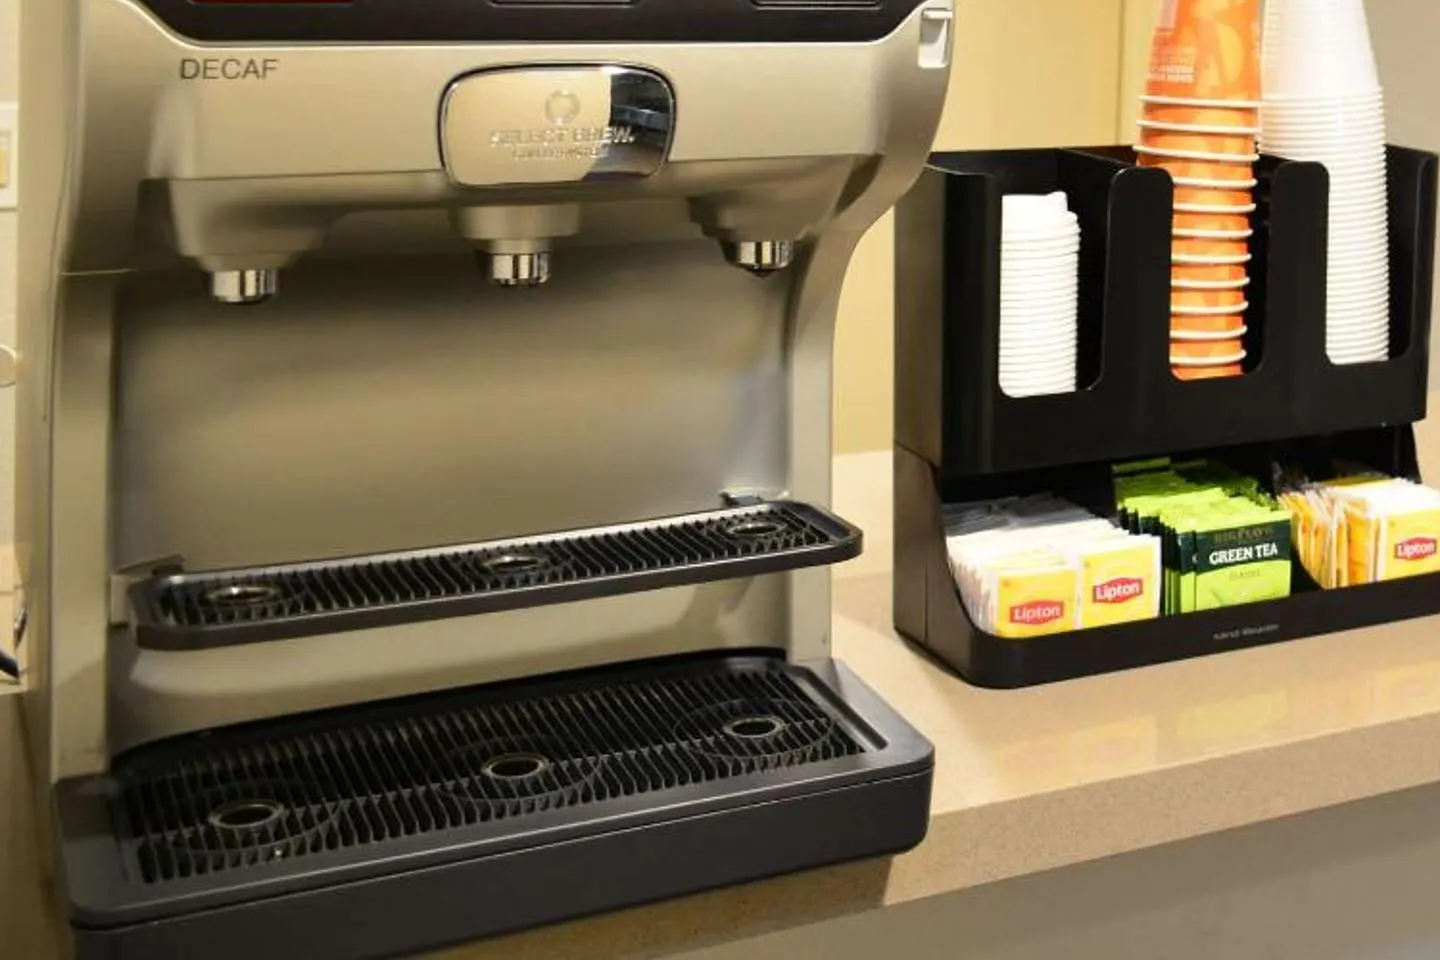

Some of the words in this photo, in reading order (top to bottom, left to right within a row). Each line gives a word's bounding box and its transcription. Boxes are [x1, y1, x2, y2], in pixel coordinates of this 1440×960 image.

[180, 57, 279, 81] DECAF
[1207, 545, 1254, 566] GREEN
[1255, 541, 1279, 559] TEA
[1395, 541, 1436, 558] Lipton
[1095, 580, 1140, 601] Lipton
[1013, 604, 1062, 623] Lipton
